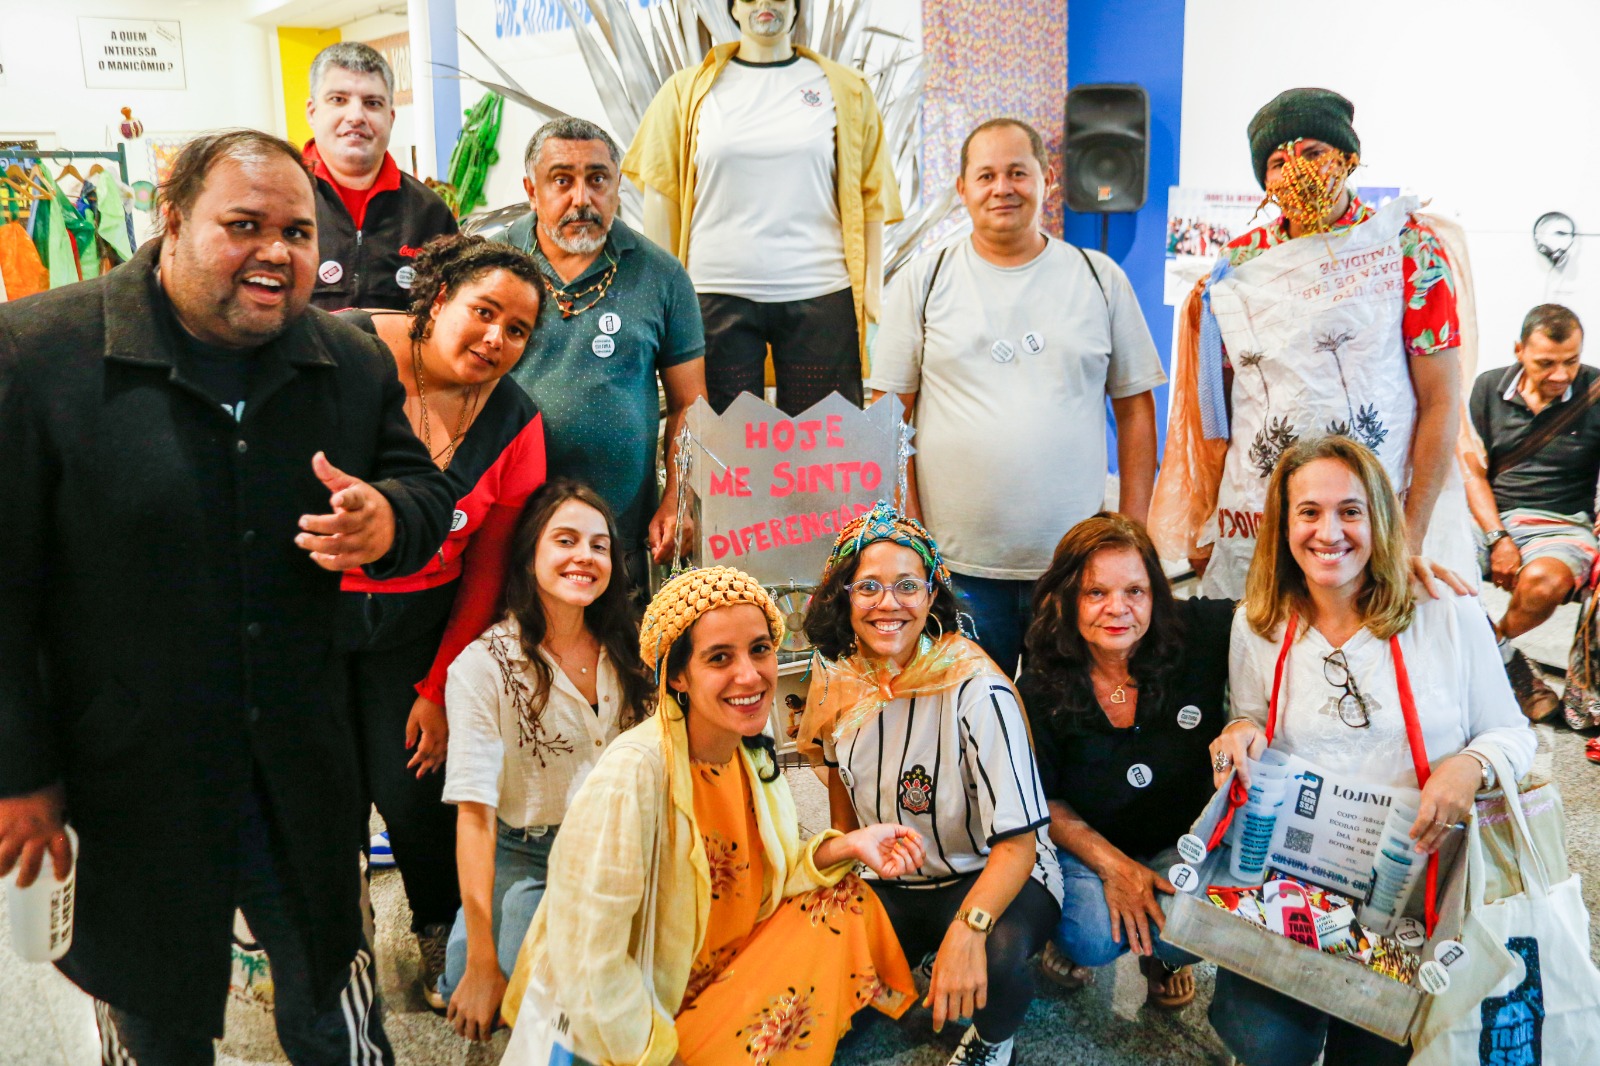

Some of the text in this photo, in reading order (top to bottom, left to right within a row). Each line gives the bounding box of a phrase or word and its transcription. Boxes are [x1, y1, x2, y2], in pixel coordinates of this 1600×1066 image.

[111, 30, 117, 41] A
[119, 31, 147, 42] QUEM
[104, 45, 157, 56] INTERESSA
[98, 60, 105, 71] O
[107, 60, 165, 72] MANICÔMIO
[745, 414, 845, 452] HOJE
[709, 460, 882, 498] ME SINTO
[708, 501, 877, 560] DIFERENCIAD
[1333, 784, 1392, 807] LOJINH
